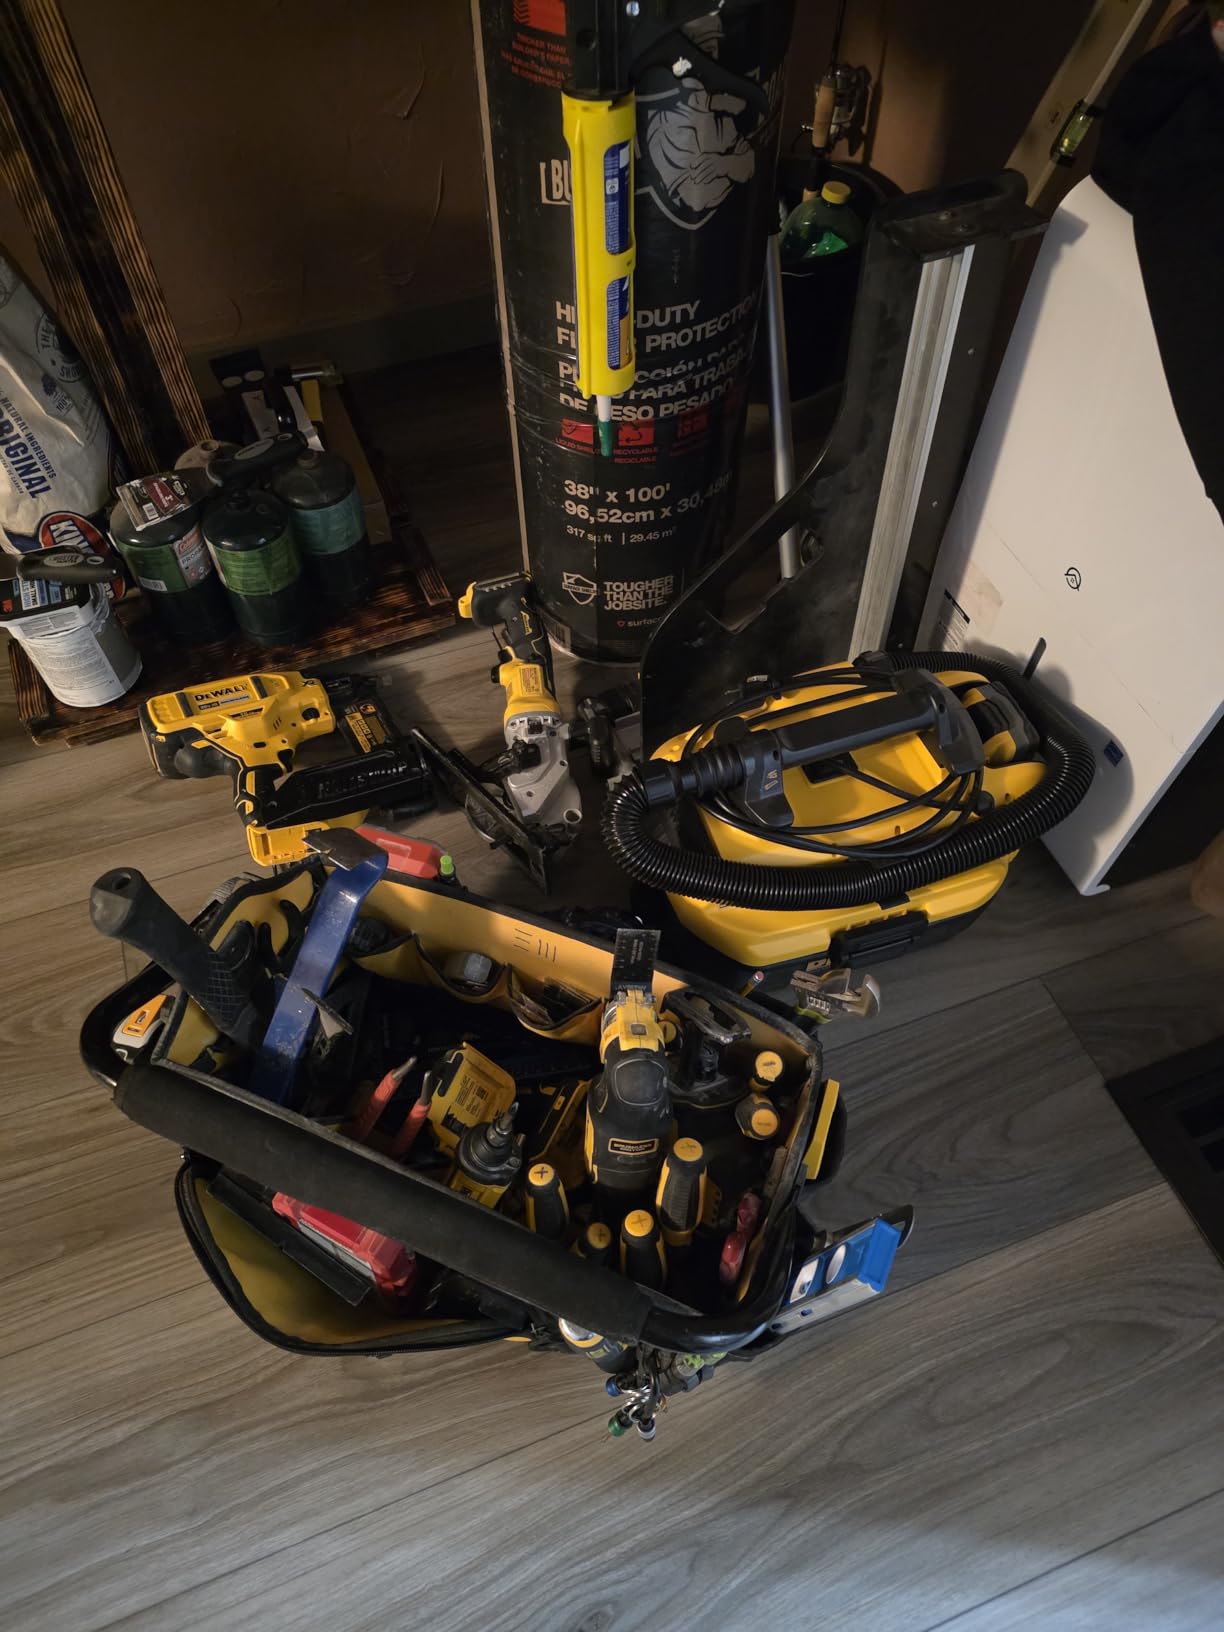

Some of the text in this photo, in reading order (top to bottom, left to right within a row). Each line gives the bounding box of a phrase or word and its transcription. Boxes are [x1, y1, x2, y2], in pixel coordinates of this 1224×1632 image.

[0, 406, 52, 499] RIGINAL
[25, 431, 57, 480] INGREDIENTS
[605, 491, 619, 504] x
[625, 482, 671, 504] 100'
[564, 499, 655, 525] 96,52cm
[659, 505, 673, 519] x
[566, 525, 585, 539] 317
[629, 530, 661, 544] 29.45
[603, 575, 674, 592] TOUGHER
[603, 585, 674, 601] THAN THE
[603, 597, 668, 611] JOBSITE.
